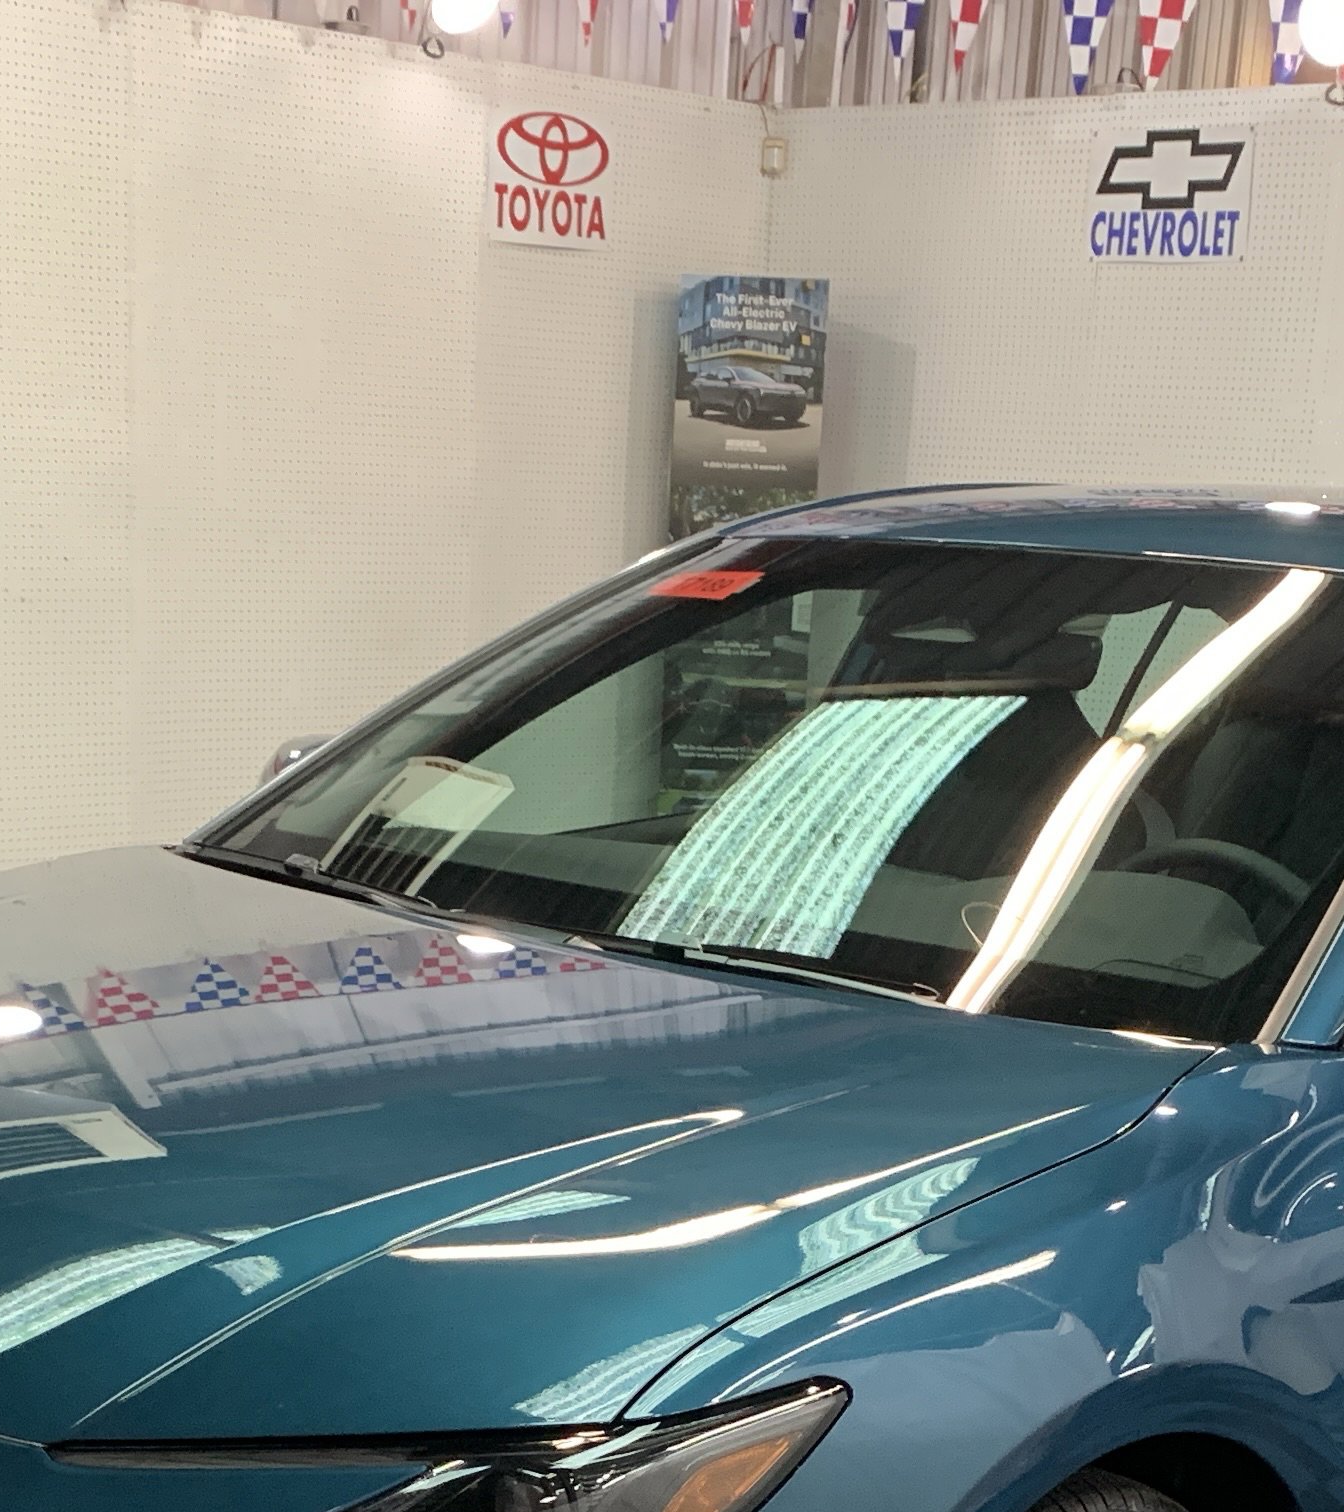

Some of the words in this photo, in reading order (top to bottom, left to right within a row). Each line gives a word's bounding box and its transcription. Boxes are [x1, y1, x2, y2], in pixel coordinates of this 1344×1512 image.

[494, 182, 606, 240] TOYOTA
[1090, 209, 1241, 257] CHEVROLET
[716, 293, 736, 305] The
[737, 294, 794, 306] First-Ever
[722, 306, 785, 319] All-Electric
[710, 318, 743, 332] Chevy
[745, 319, 780, 332] Blazer
[782, 320, 798, 332] EV
